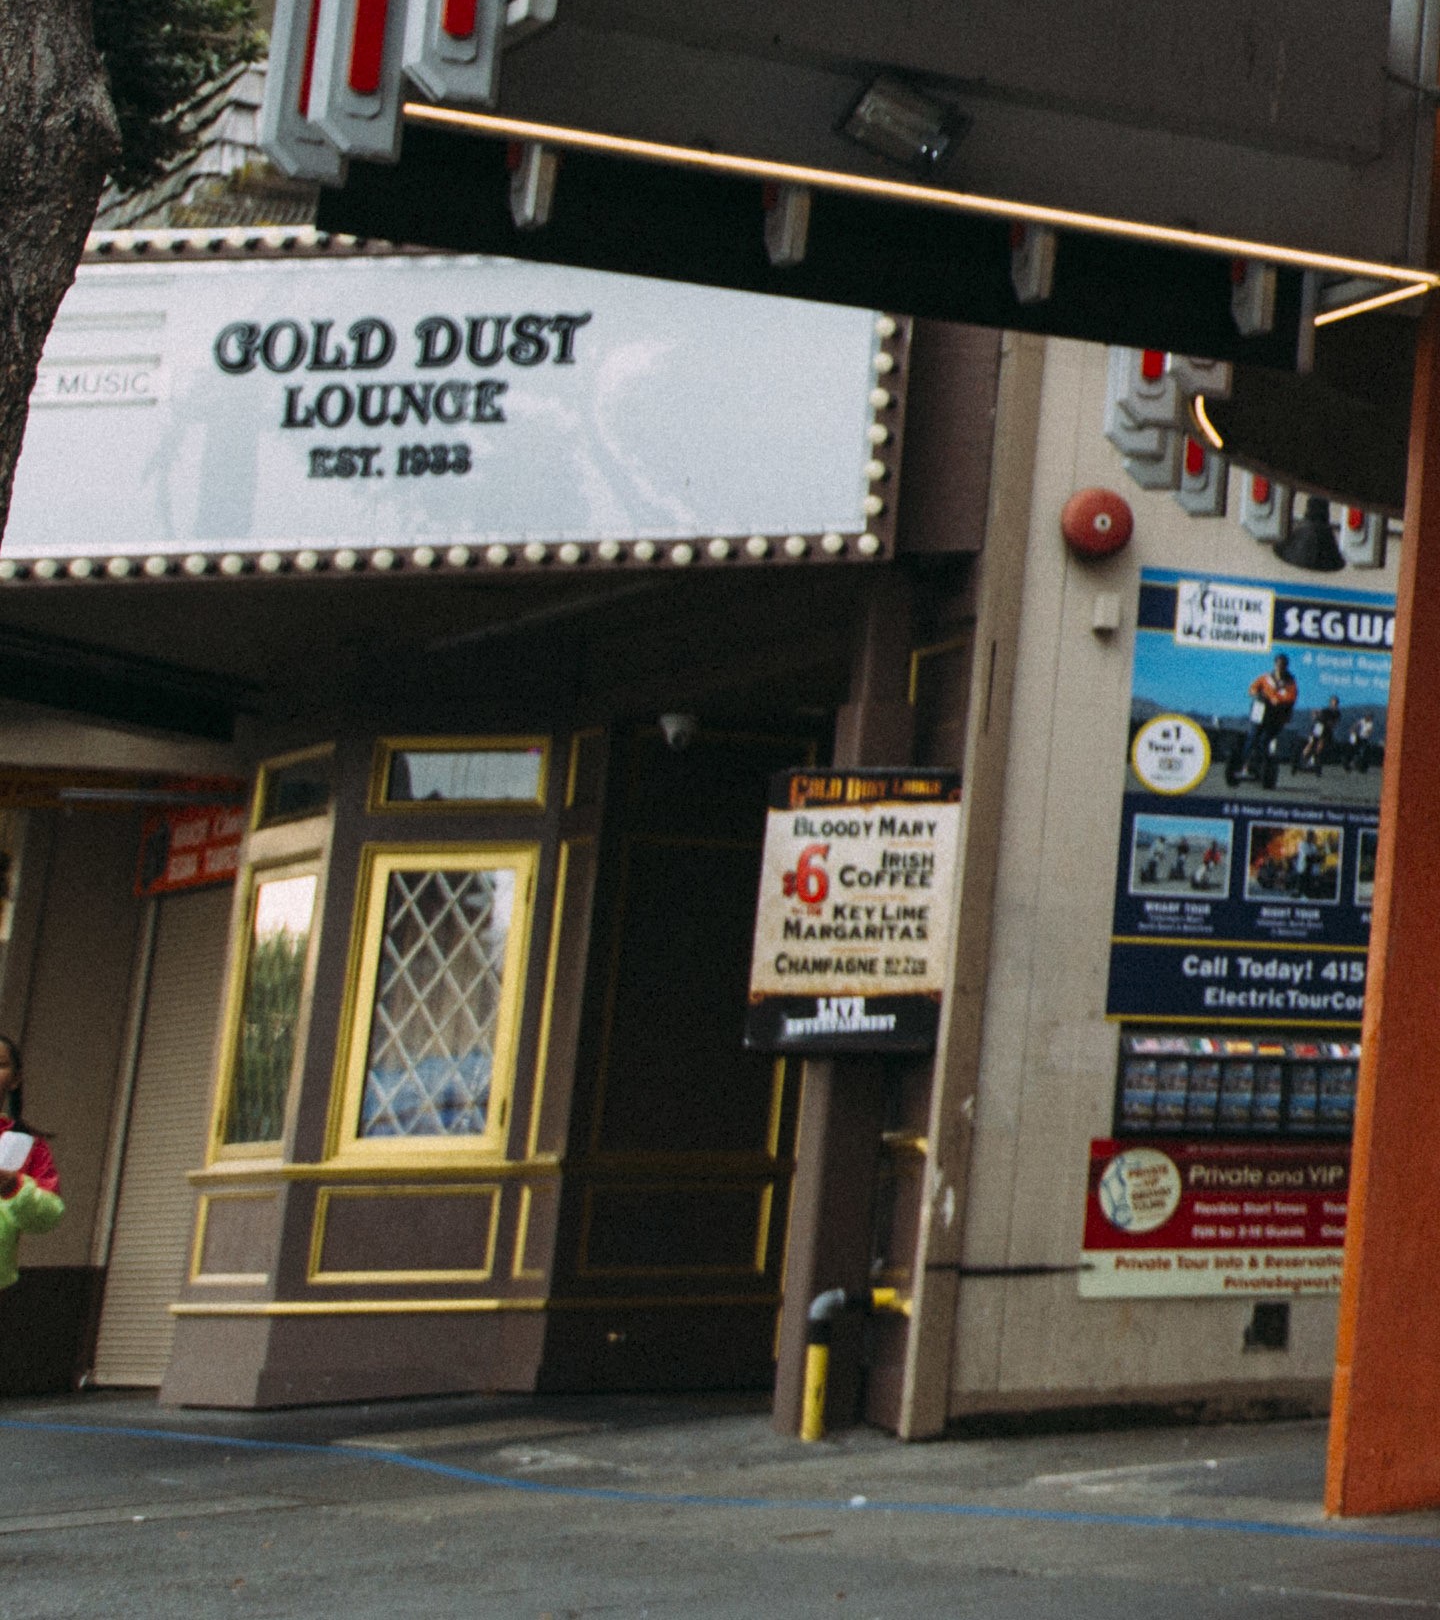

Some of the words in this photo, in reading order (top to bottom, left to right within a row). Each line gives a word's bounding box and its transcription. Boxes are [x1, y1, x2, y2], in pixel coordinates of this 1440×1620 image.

[213, 315, 396, 375] GOLD
[413, 311, 593, 369] DUST
[56, 371, 151, 397] MUSIC
[280, 379, 509, 430] LOUNGE
[308, 445, 385, 479] EST.
[793, 815, 874, 838] BLOODY
[878, 815, 938, 838] MARY
[881, 849, 935, 869] IRISH
[838, 864, 933, 889] COFFEE
[832, 904, 875, 921] KEY
[880, 904, 930, 921] LIME
[783, 918, 929, 941] MARGARITAS
[774, 951, 879, 975] CHAMPAGNE
[1182, 954, 1229, 978] Call
[1236, 956, 1313, 985] Today!
[1189, 1164, 1264, 1186] Private
[1307, 1165, 1345, 1185] VIP
